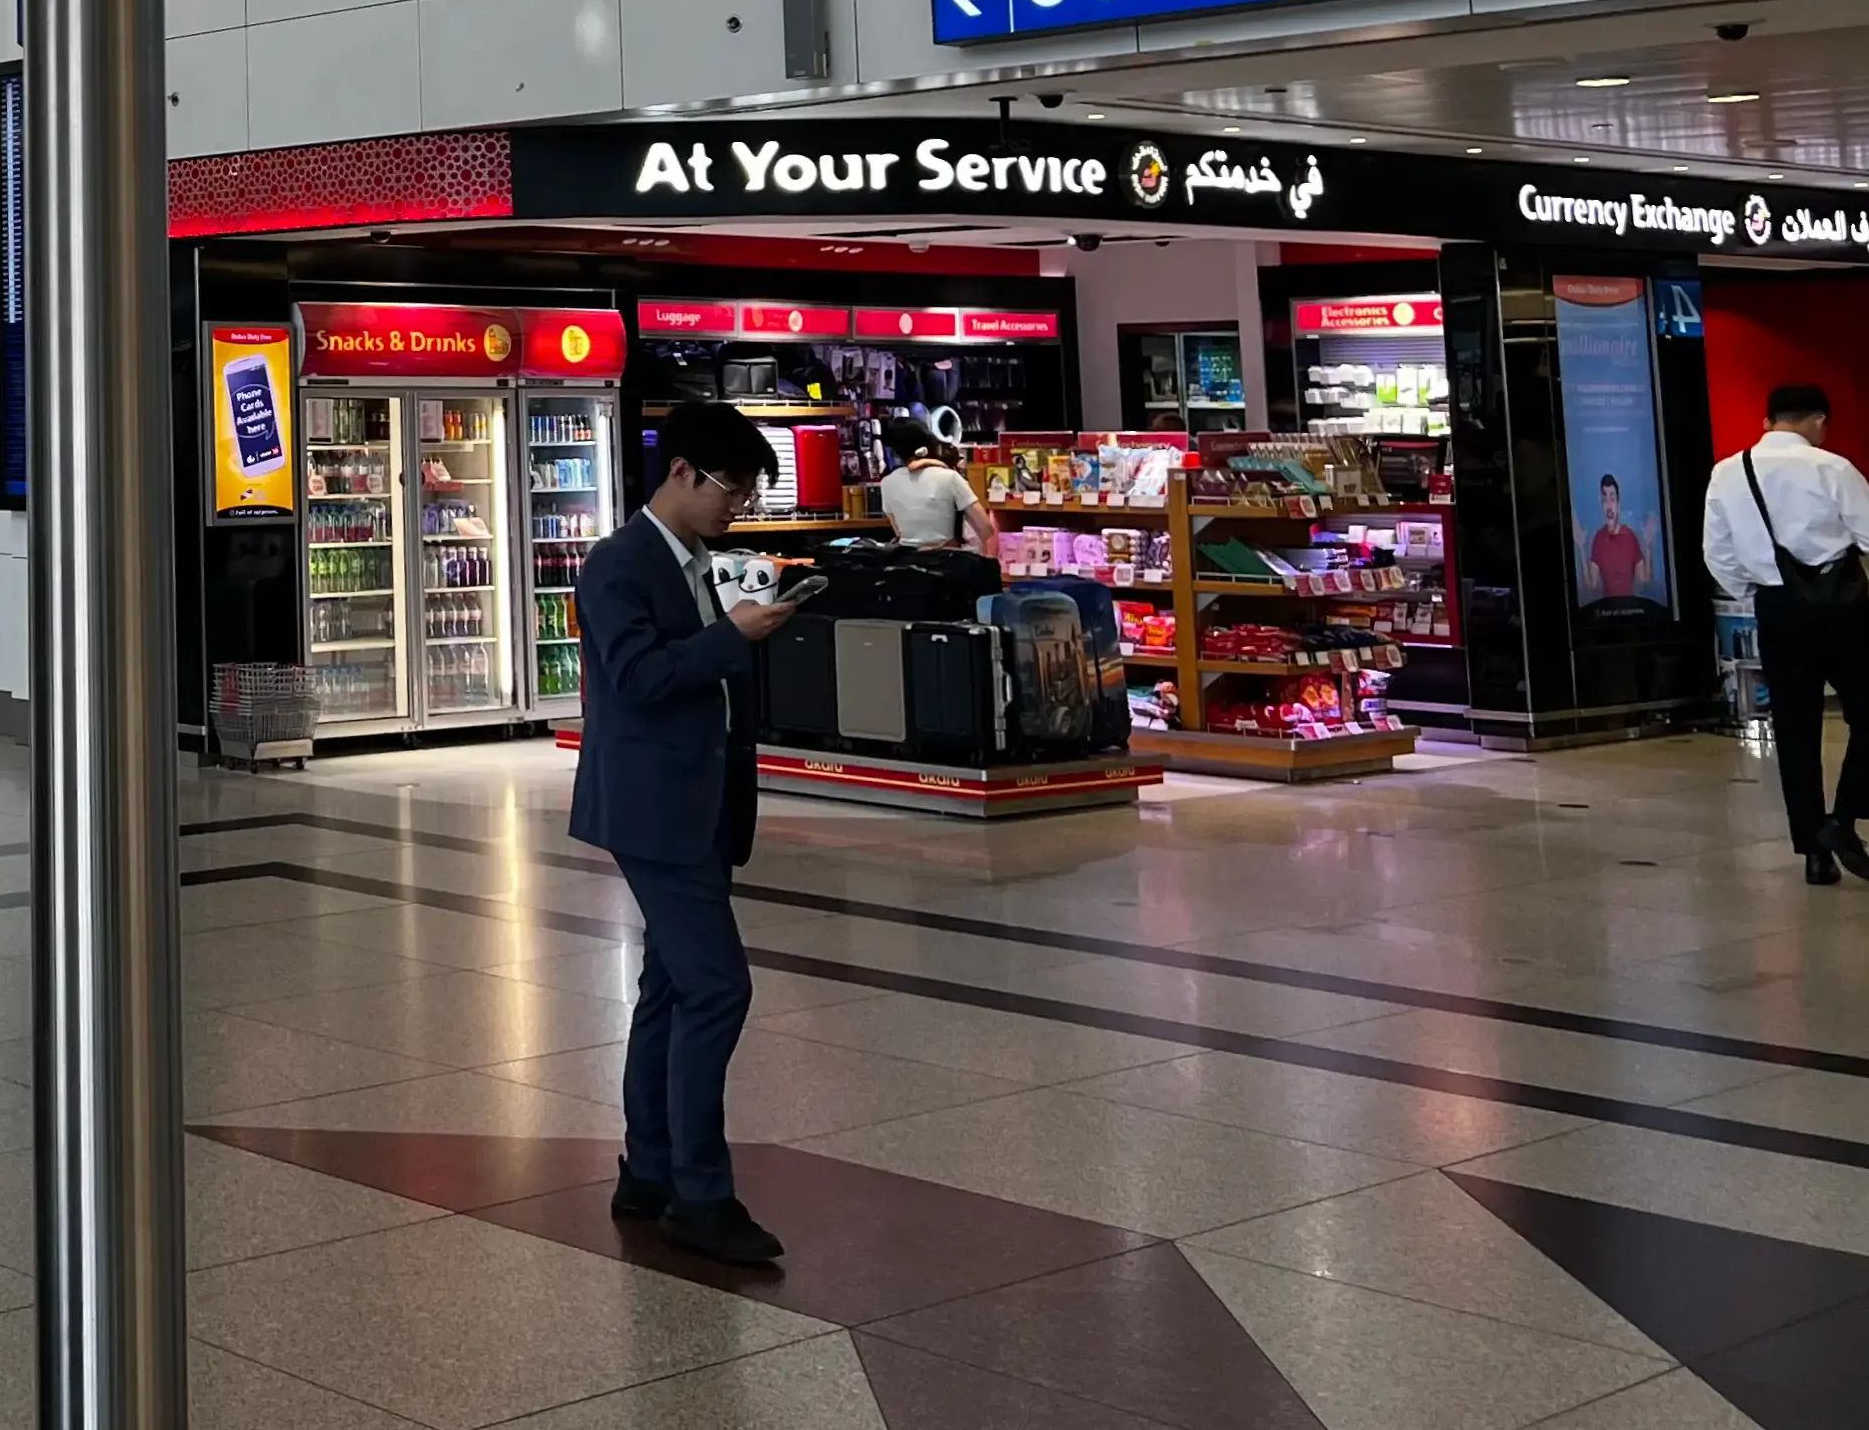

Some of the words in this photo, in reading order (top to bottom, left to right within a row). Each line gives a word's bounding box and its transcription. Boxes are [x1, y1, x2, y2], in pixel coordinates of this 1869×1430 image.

[636, 142, 715, 194] At
[731, 141, 899, 193] Your
[916, 138, 1107, 195] Service
[1289, 154, 1324, 219] في
[1518, 183, 1629, 236] Currency
[1630, 193, 1736, 245] Exchange
[655, 308, 701, 327] Luggage
[1321, 306, 1388, 318] Electronics
[971, 318, 999, 331] Travel
[1321, 316, 1390, 328] Accessories
[316, 329, 385, 351] Snacks
[390, 330, 405, 352] &
[409, 330, 476, 353] Drinks
[236, 388, 262, 401] Phone
[240, 399, 264, 412] Cards
[246, 423, 267, 434] here
